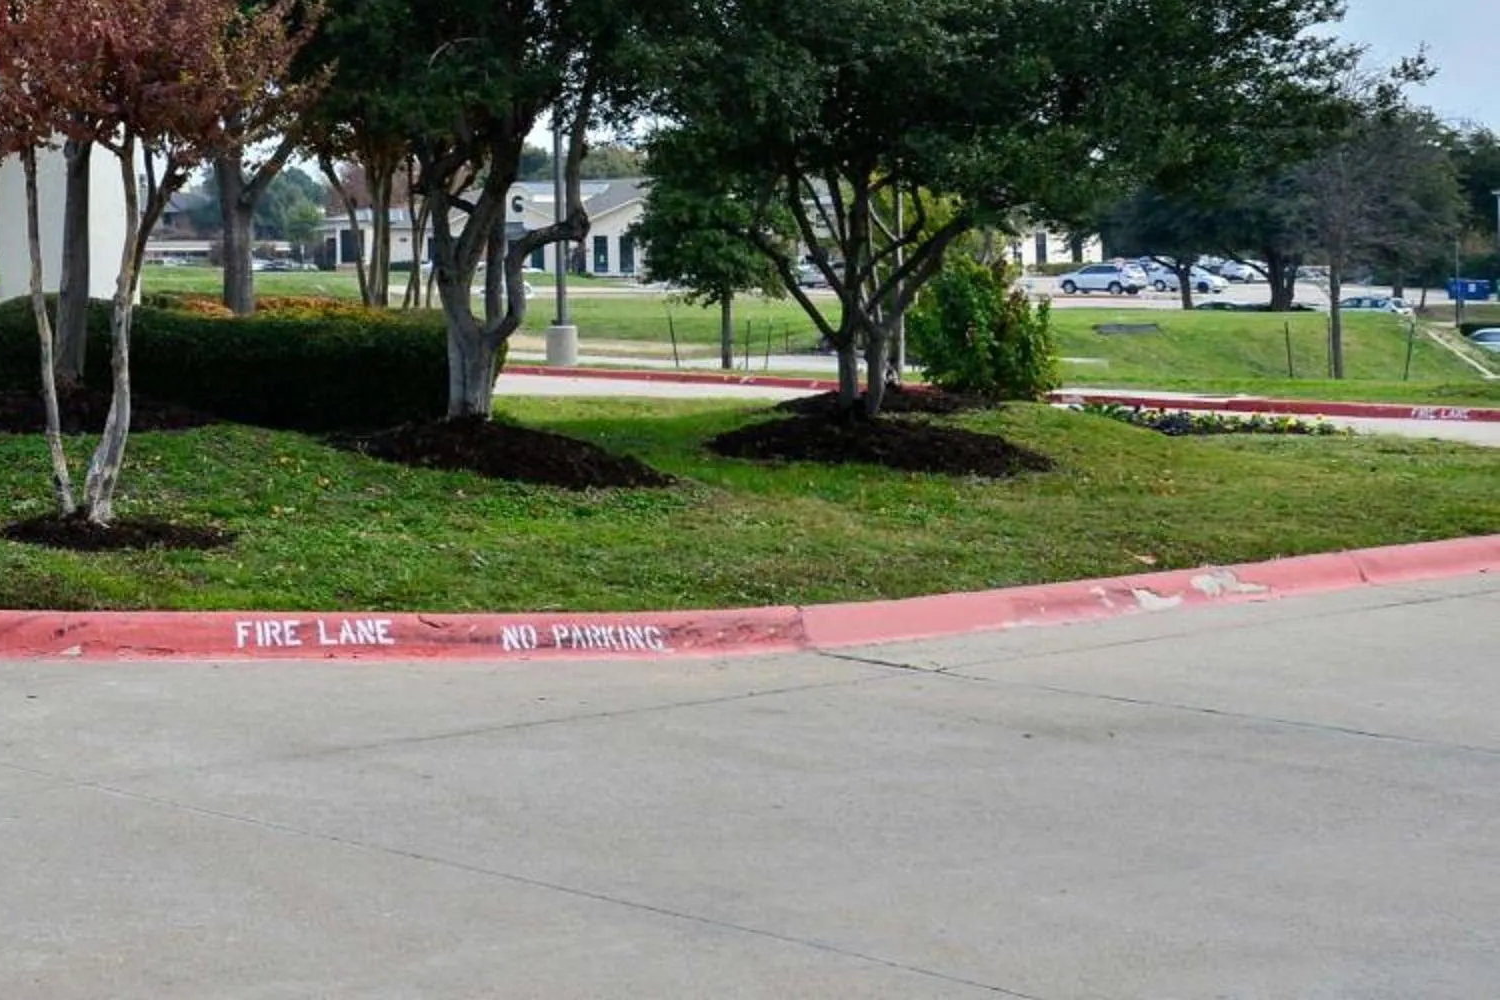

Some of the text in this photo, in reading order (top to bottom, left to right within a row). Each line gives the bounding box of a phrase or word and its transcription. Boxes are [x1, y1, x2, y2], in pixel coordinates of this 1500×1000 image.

[236, 618, 395, 648] FIRE LANE
[501, 623, 665, 652] NO PARKING
